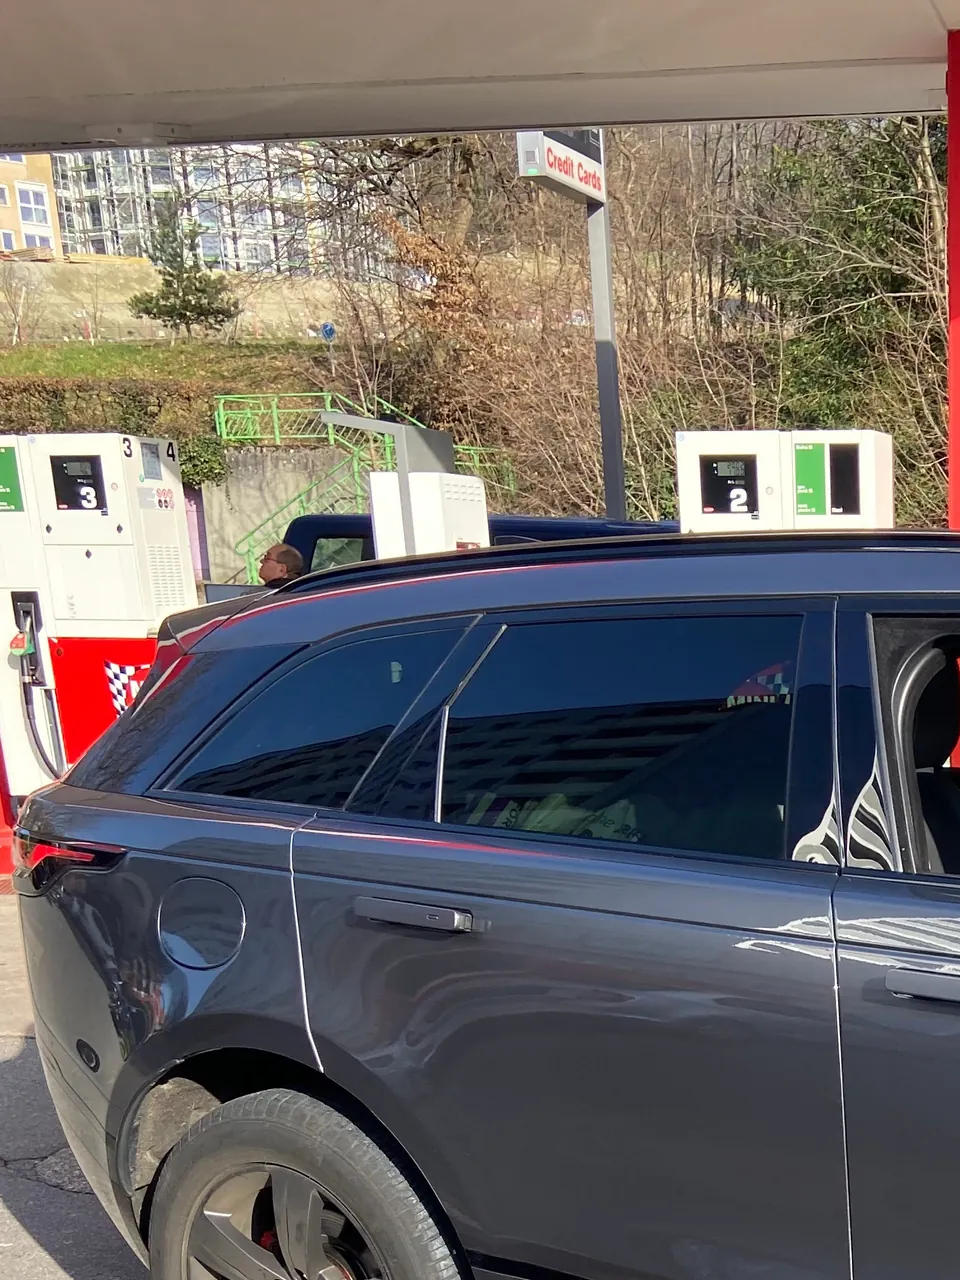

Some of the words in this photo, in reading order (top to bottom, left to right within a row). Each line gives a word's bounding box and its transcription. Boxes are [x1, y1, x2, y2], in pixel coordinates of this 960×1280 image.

[546, 147, 574, 178] Credit
[577, 162, 602, 192] Cards
[122, 437, 133, 458] 3
[166, 442, 176, 462] 4
[80, 486, 98, 509] 3
[729, 488, 749, 512] 2
